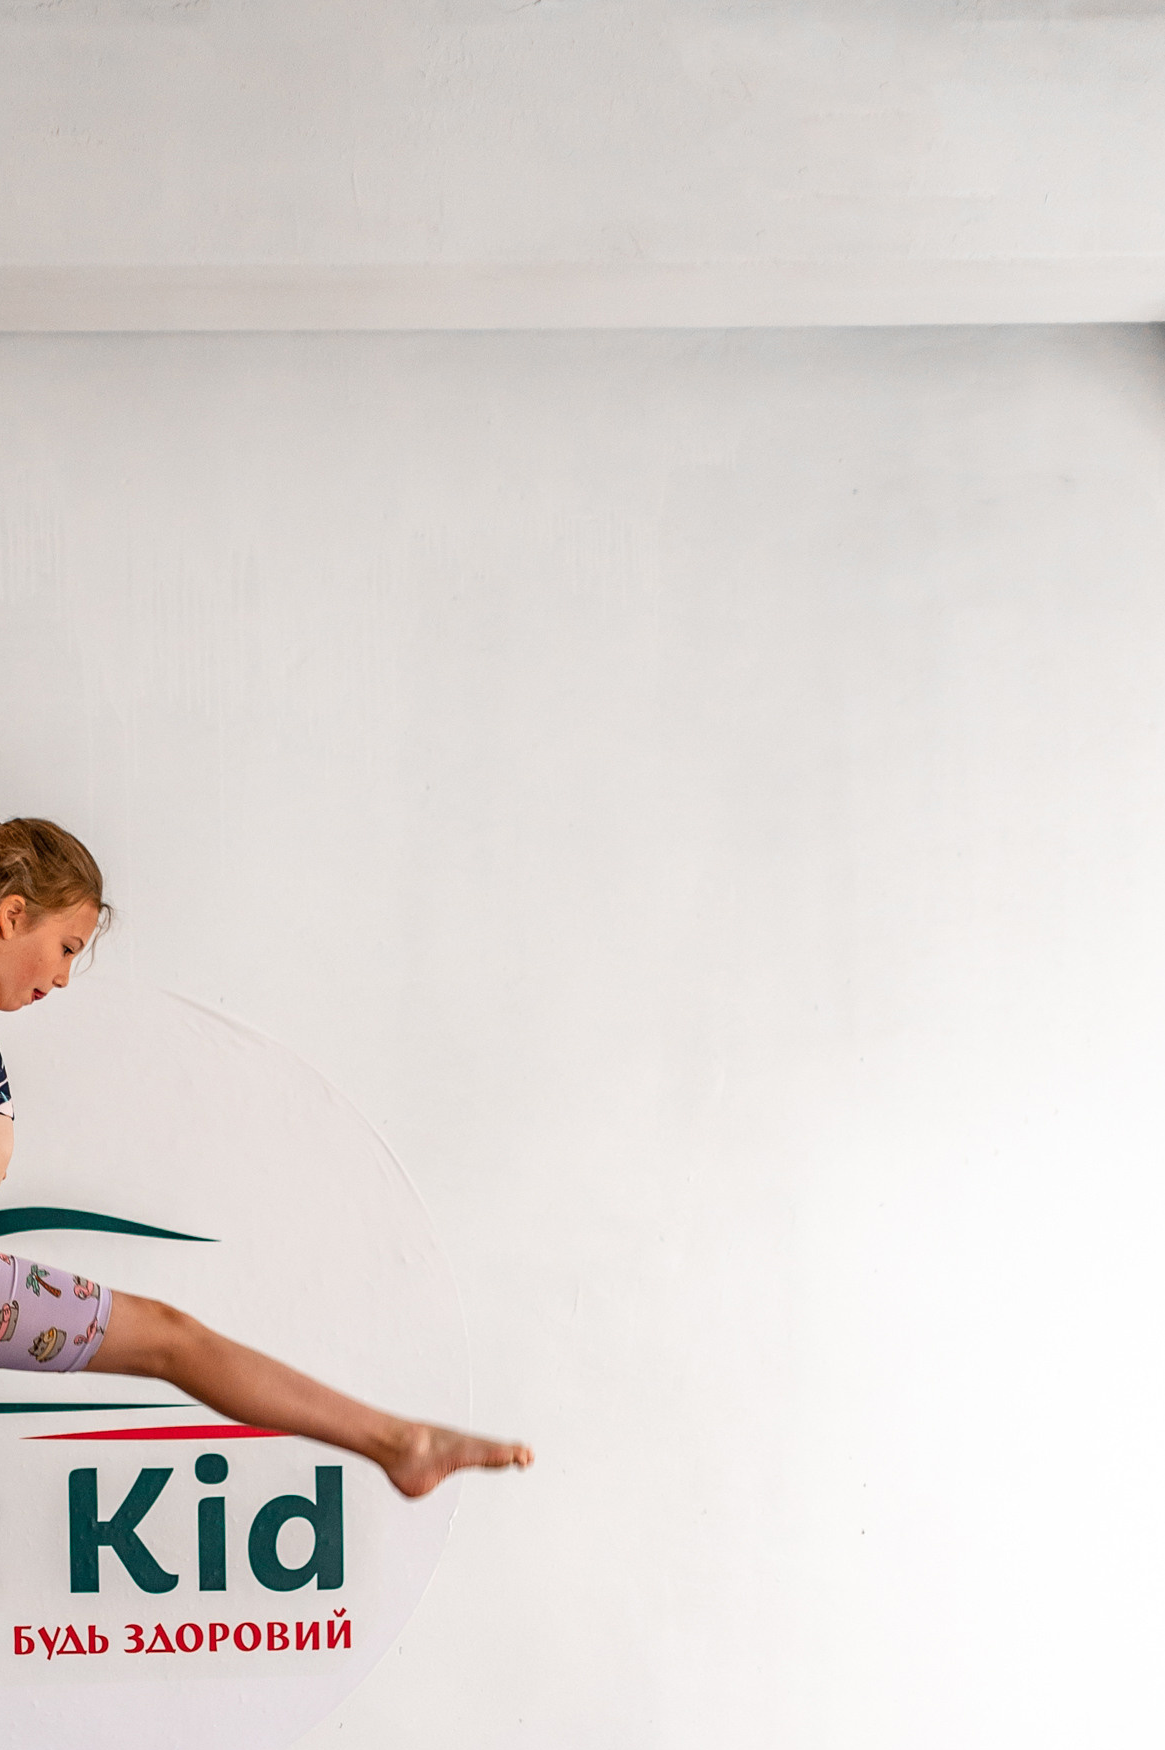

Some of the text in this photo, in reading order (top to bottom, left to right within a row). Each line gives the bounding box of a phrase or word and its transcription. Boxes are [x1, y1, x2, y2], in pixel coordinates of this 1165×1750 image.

[68, 1453, 344, 1594] Kid
[13, 1607, 352, 1661] БУДЬ ЗДОРОВИЙ
